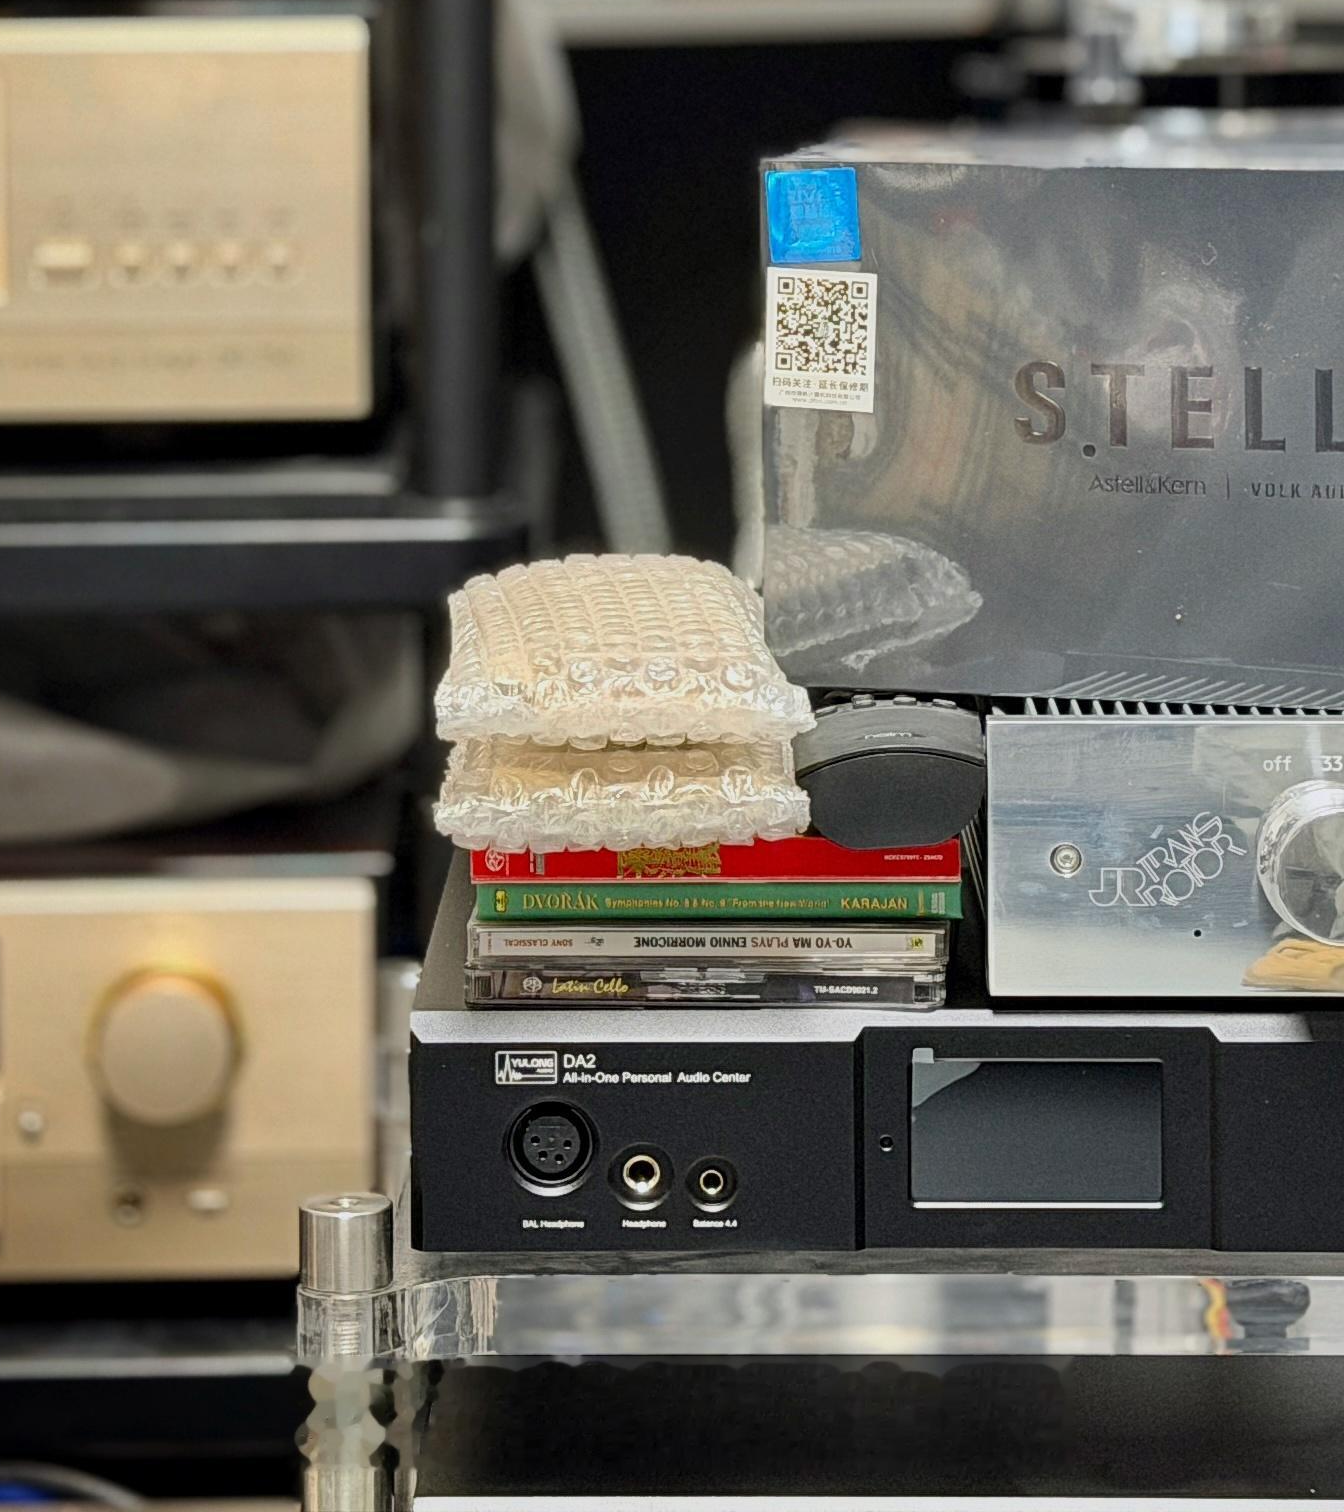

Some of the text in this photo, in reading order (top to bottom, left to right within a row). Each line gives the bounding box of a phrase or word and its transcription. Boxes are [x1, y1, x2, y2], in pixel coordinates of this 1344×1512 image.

[1090, 474, 1207, 495] Astell&Kern
[1251, 482, 1300, 499] VOLK
[1262, 755, 1292, 772] off
[1321, 755, 1344, 772] 33
[841, 897, 908, 910] KARAJAN
[634, 936, 853, 949] YO-YO MA PLAYS ENNIO MORRICONE
[552, 976, 629, 994] Latin Cello
[511, 1057, 554, 1068] YULONG
[563, 1054, 597, 1069] DA2
[621, 1072, 673, 1084] Personal
[677, 1072, 711, 1084] Audio
[712, 1072, 752, 1084] Center
[522, 1219, 585, 1230] BAL Headphone
[621, 1219, 667, 1230] Headphone
